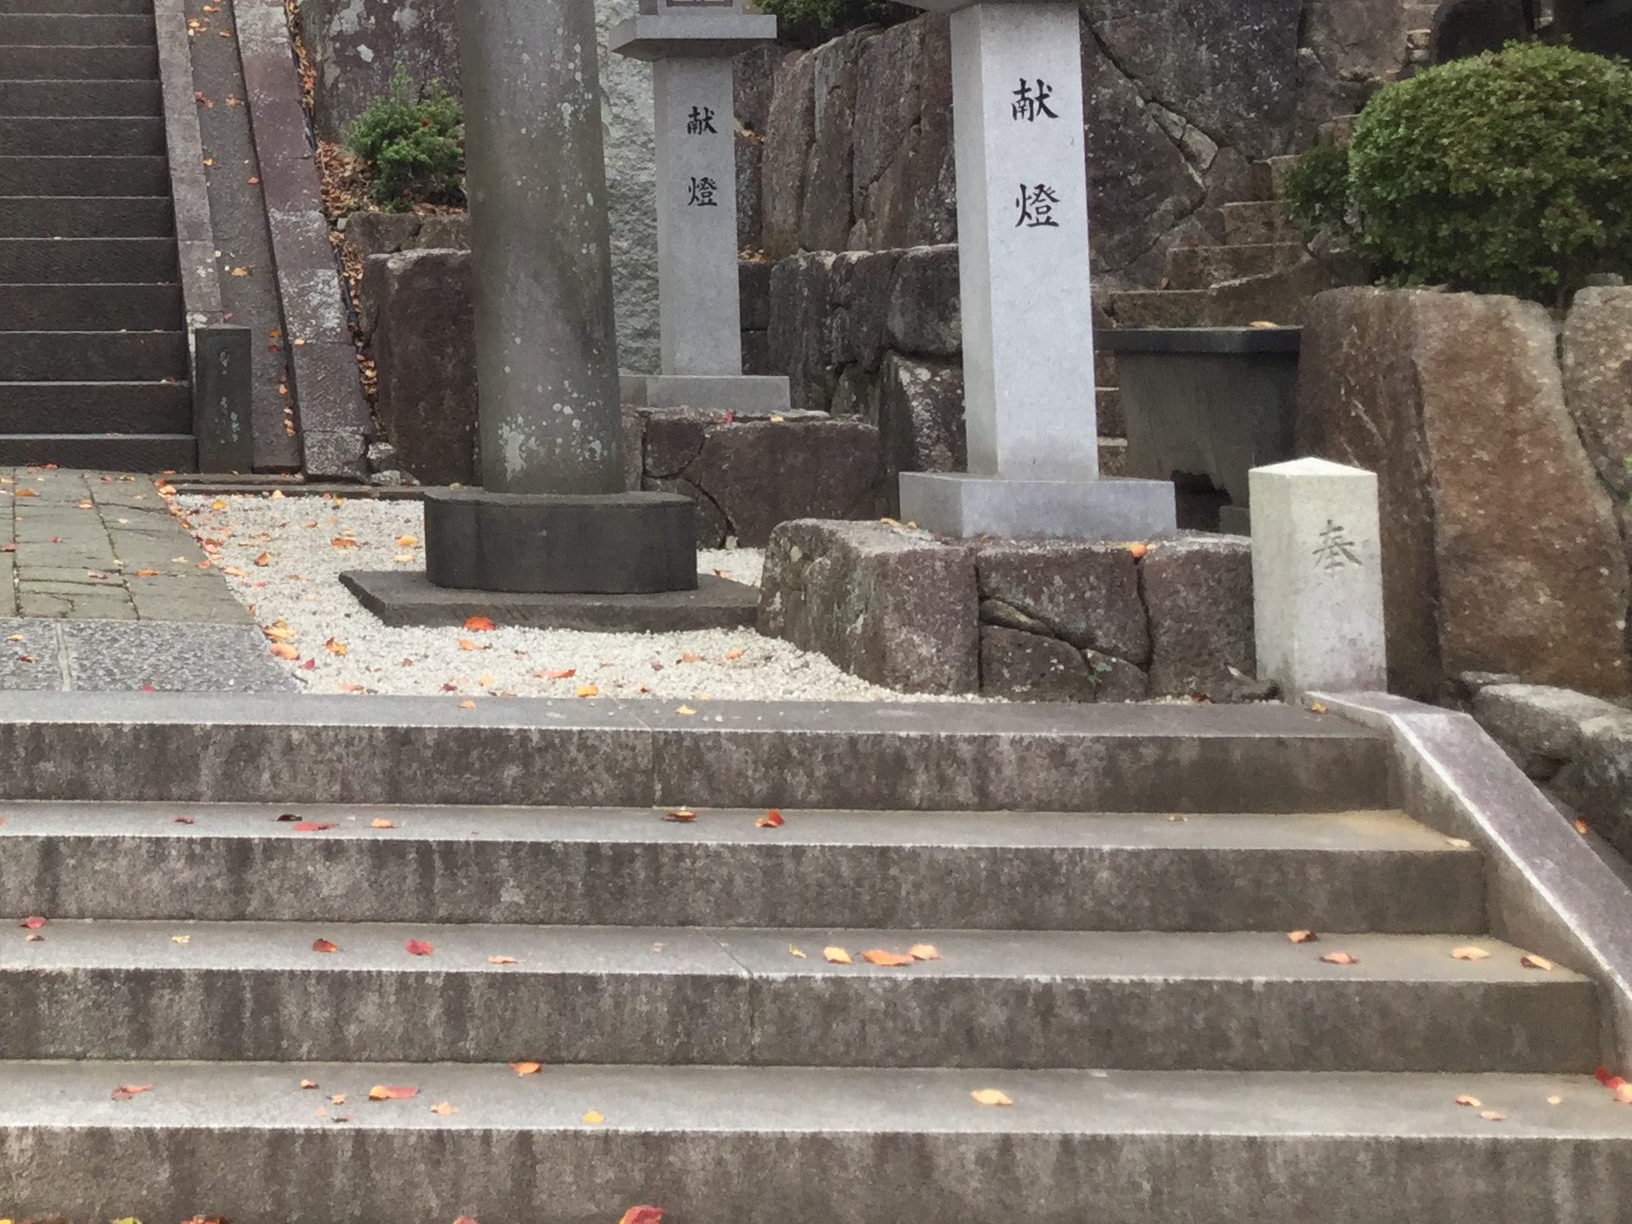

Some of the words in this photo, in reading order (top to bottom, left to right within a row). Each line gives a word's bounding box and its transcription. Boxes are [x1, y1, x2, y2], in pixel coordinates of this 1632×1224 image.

[686, 105, 719, 207] 献燈
[1011, 77, 1061, 228] 献燈
[1311, 518, 1363, 577] 奉
